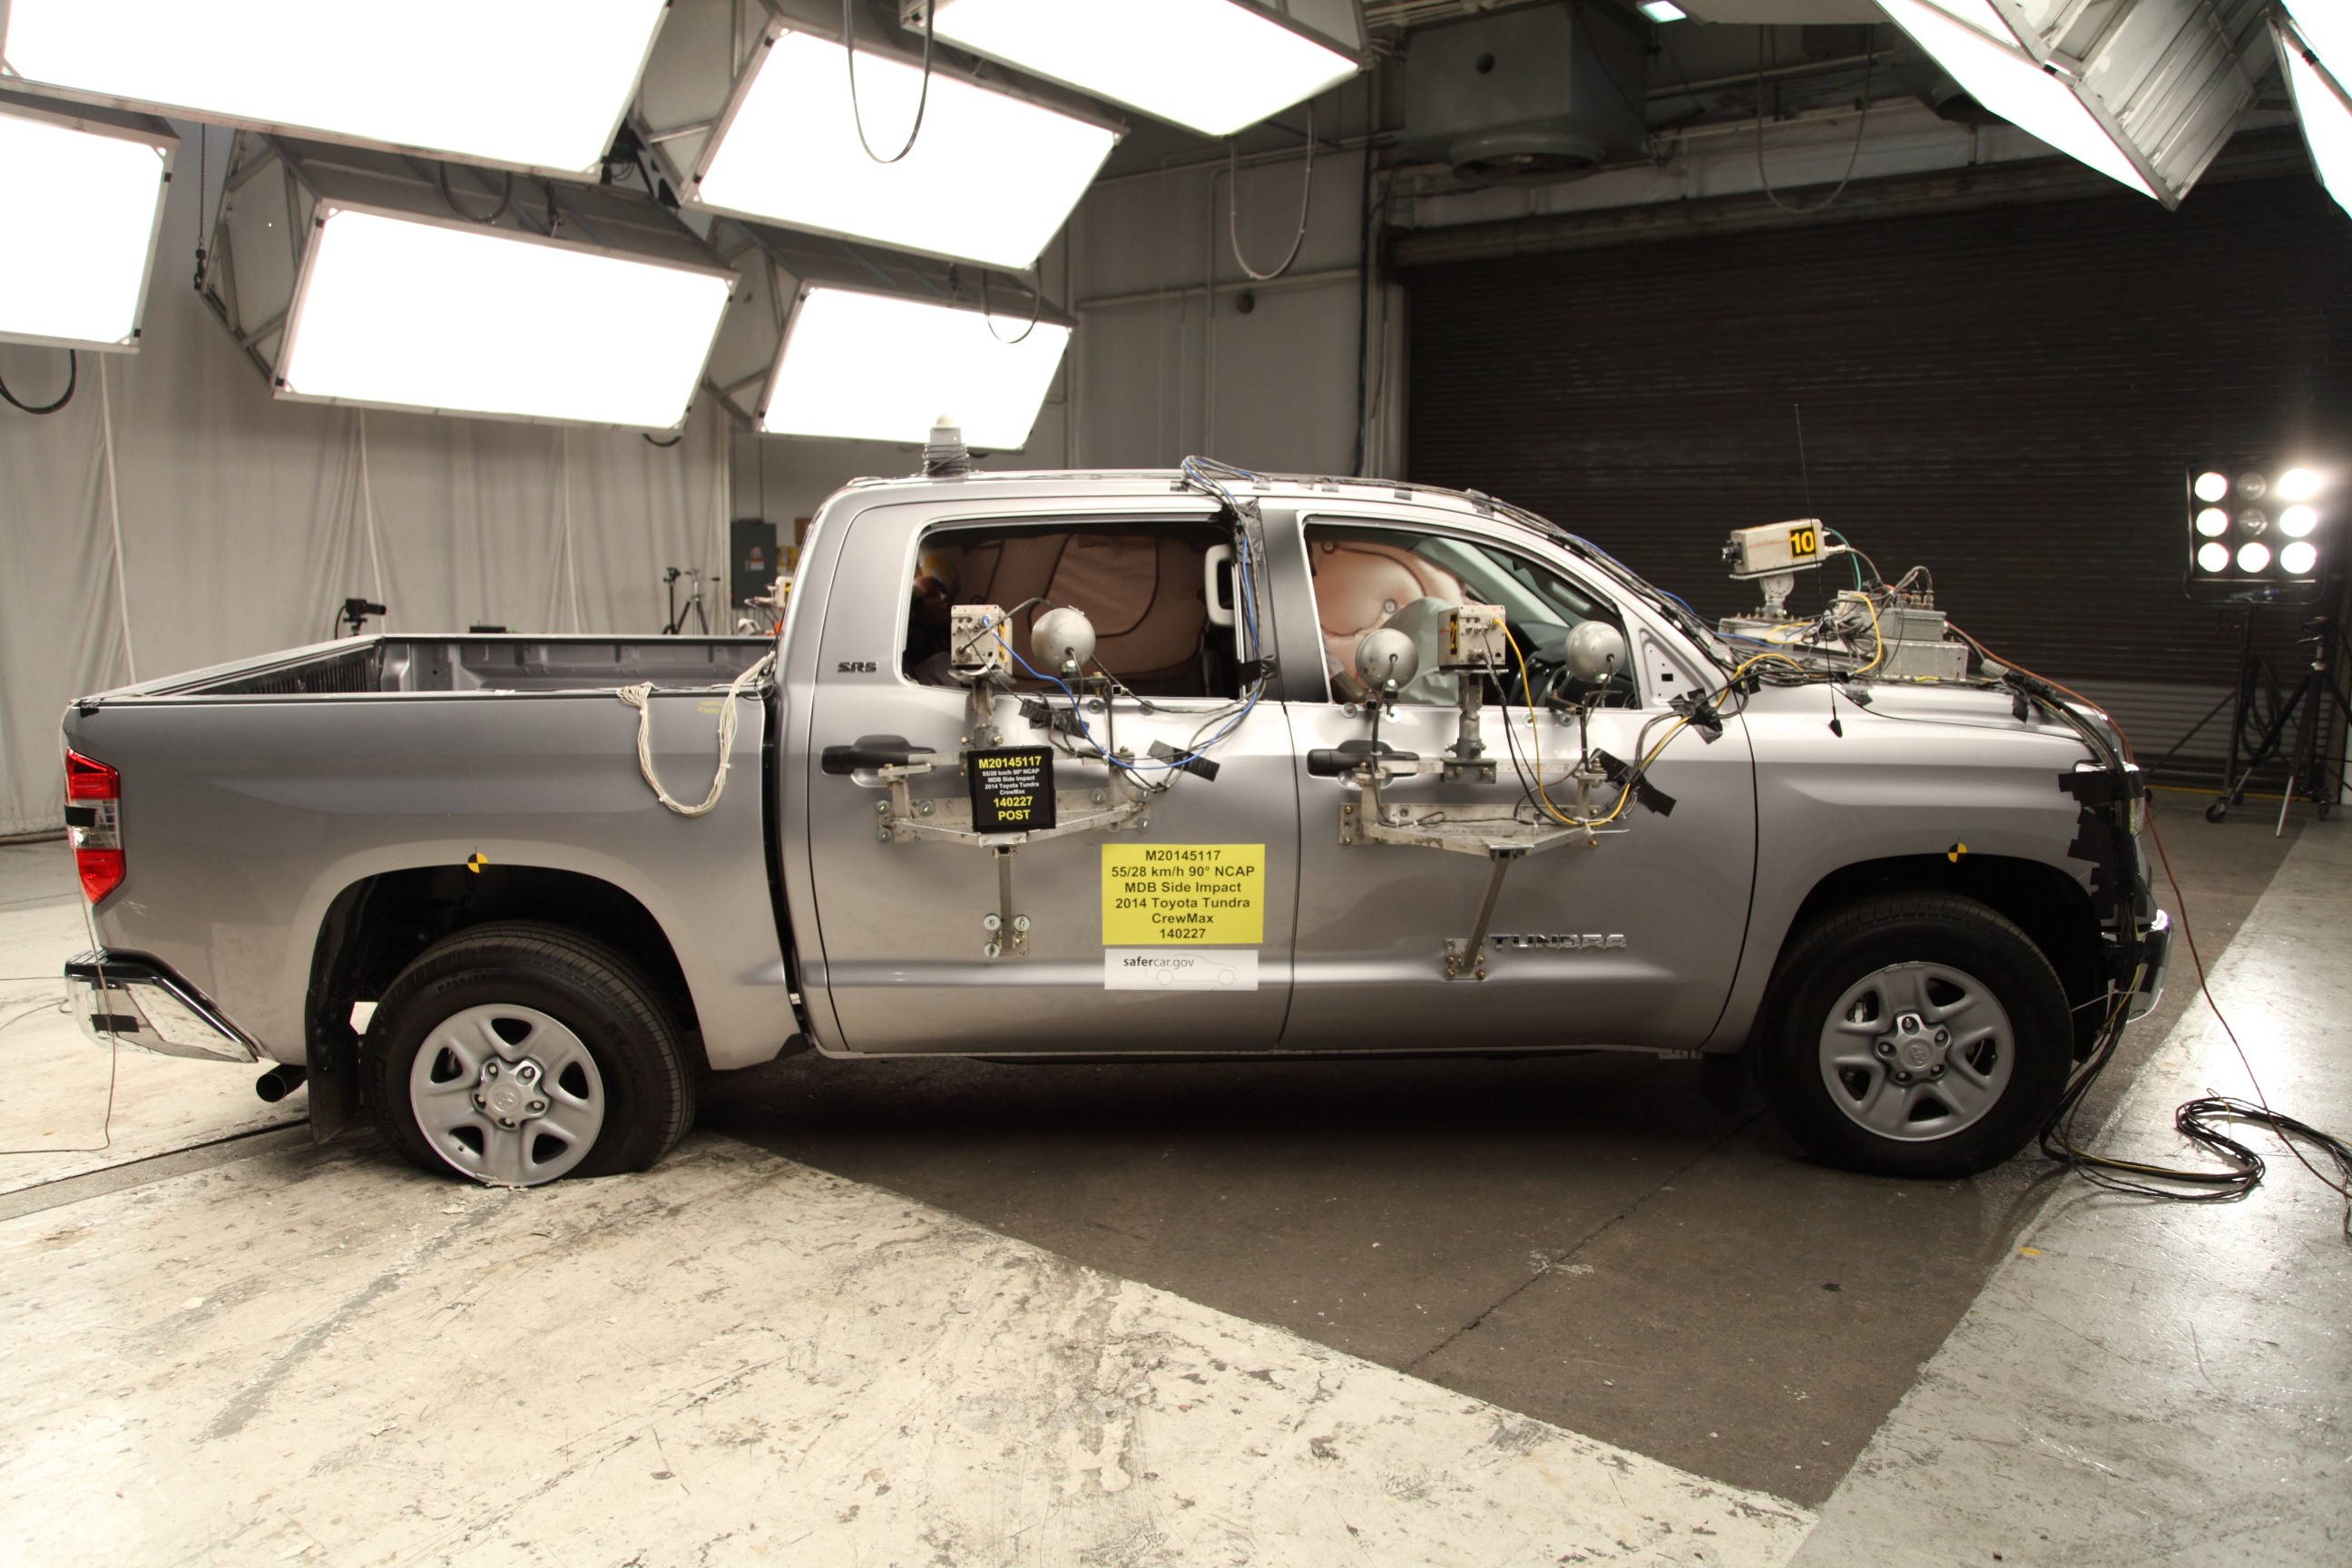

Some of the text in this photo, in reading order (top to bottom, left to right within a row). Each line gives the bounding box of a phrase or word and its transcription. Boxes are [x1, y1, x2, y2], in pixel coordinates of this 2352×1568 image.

[1790, 531, 1816, 554] 10
[978, 756, 1042, 769] M20145117
[994, 796, 1033, 808] 140227
[998, 809, 1031, 821] POST
[1145, 850, 1221, 861] M20145117
[1112, 866, 1255, 877] 55/28 km/h 90° NCAP
[1124, 881, 1241, 895] MDB Side Impact
[1115, 897, 1250, 910] 2014 Toyota Tundra
[1152, 913, 1214, 924] CrewMax
[1160, 928, 1206, 939] 140227
[1488, 934, 1627, 949] TUNDRA
[1123, 956, 1194, 970] safercar.gov
